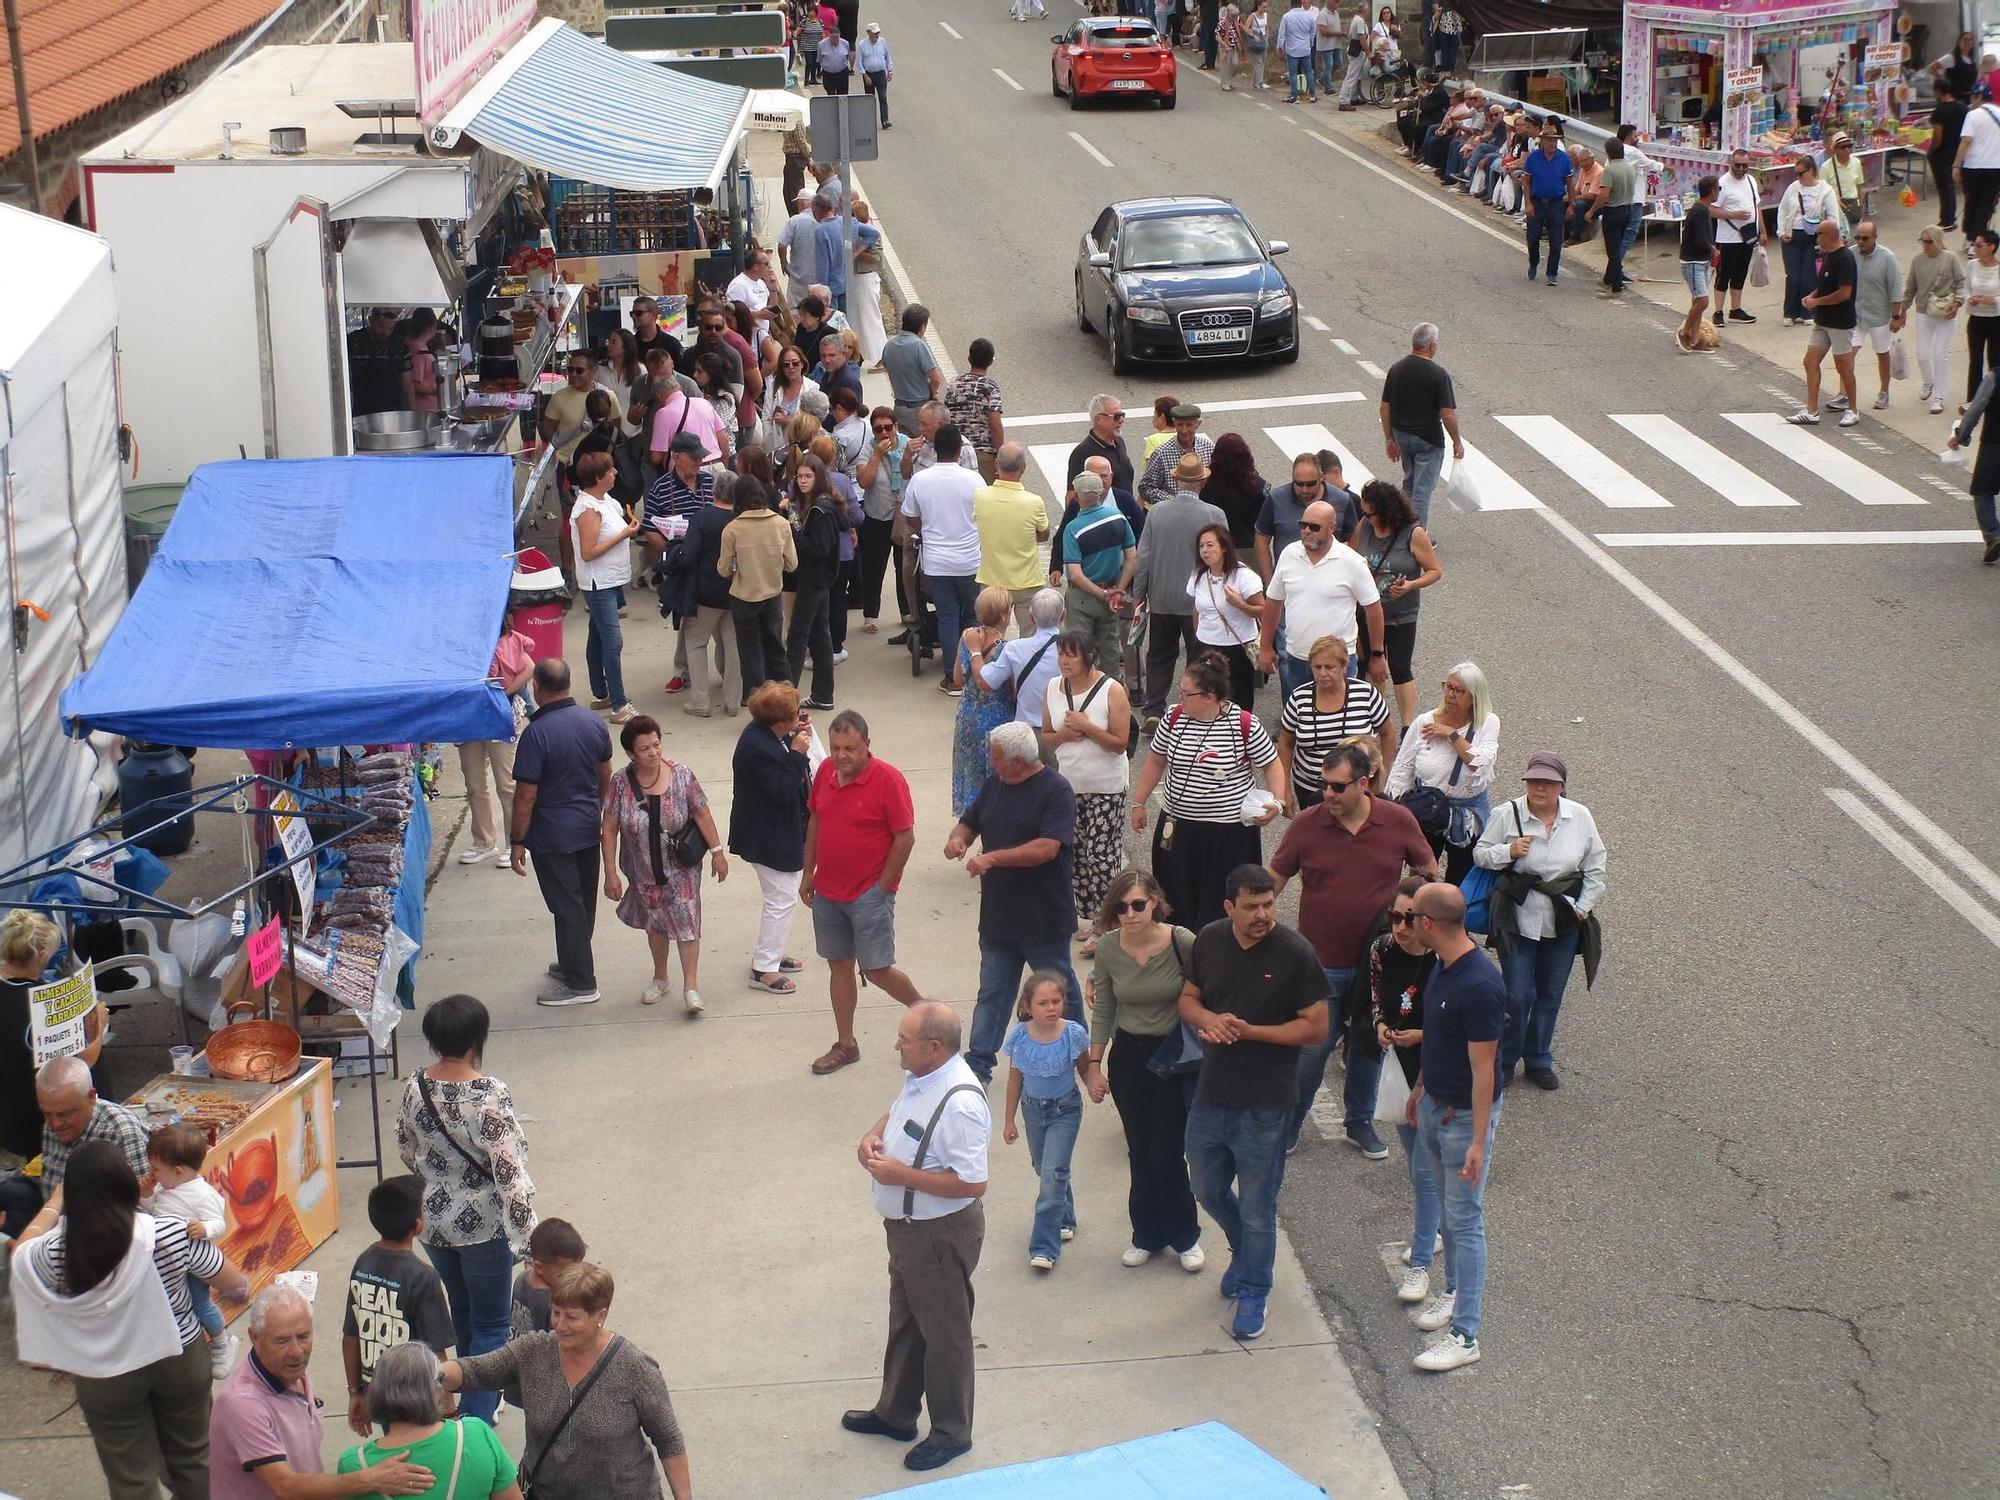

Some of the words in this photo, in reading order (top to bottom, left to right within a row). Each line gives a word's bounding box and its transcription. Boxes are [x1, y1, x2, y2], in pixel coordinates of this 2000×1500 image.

[754, 112, 787, 123] Mahou
[1197, 331, 1222, 341] 4894
[1225, 329, 1244, 340] DLW
[44, 1000, 53, 1014] Y
[37, 1035, 41, 1046] 1
[44, 1029, 71, 1045] PAQUETE
[74, 1023, 78, 1034] 3
[38, 1052, 43, 1063] 2
[45, 1044, 74, 1061] PAQUETES
[76, 1039, 80, 1050] 5
[350, 1279, 403, 1318] REAL
